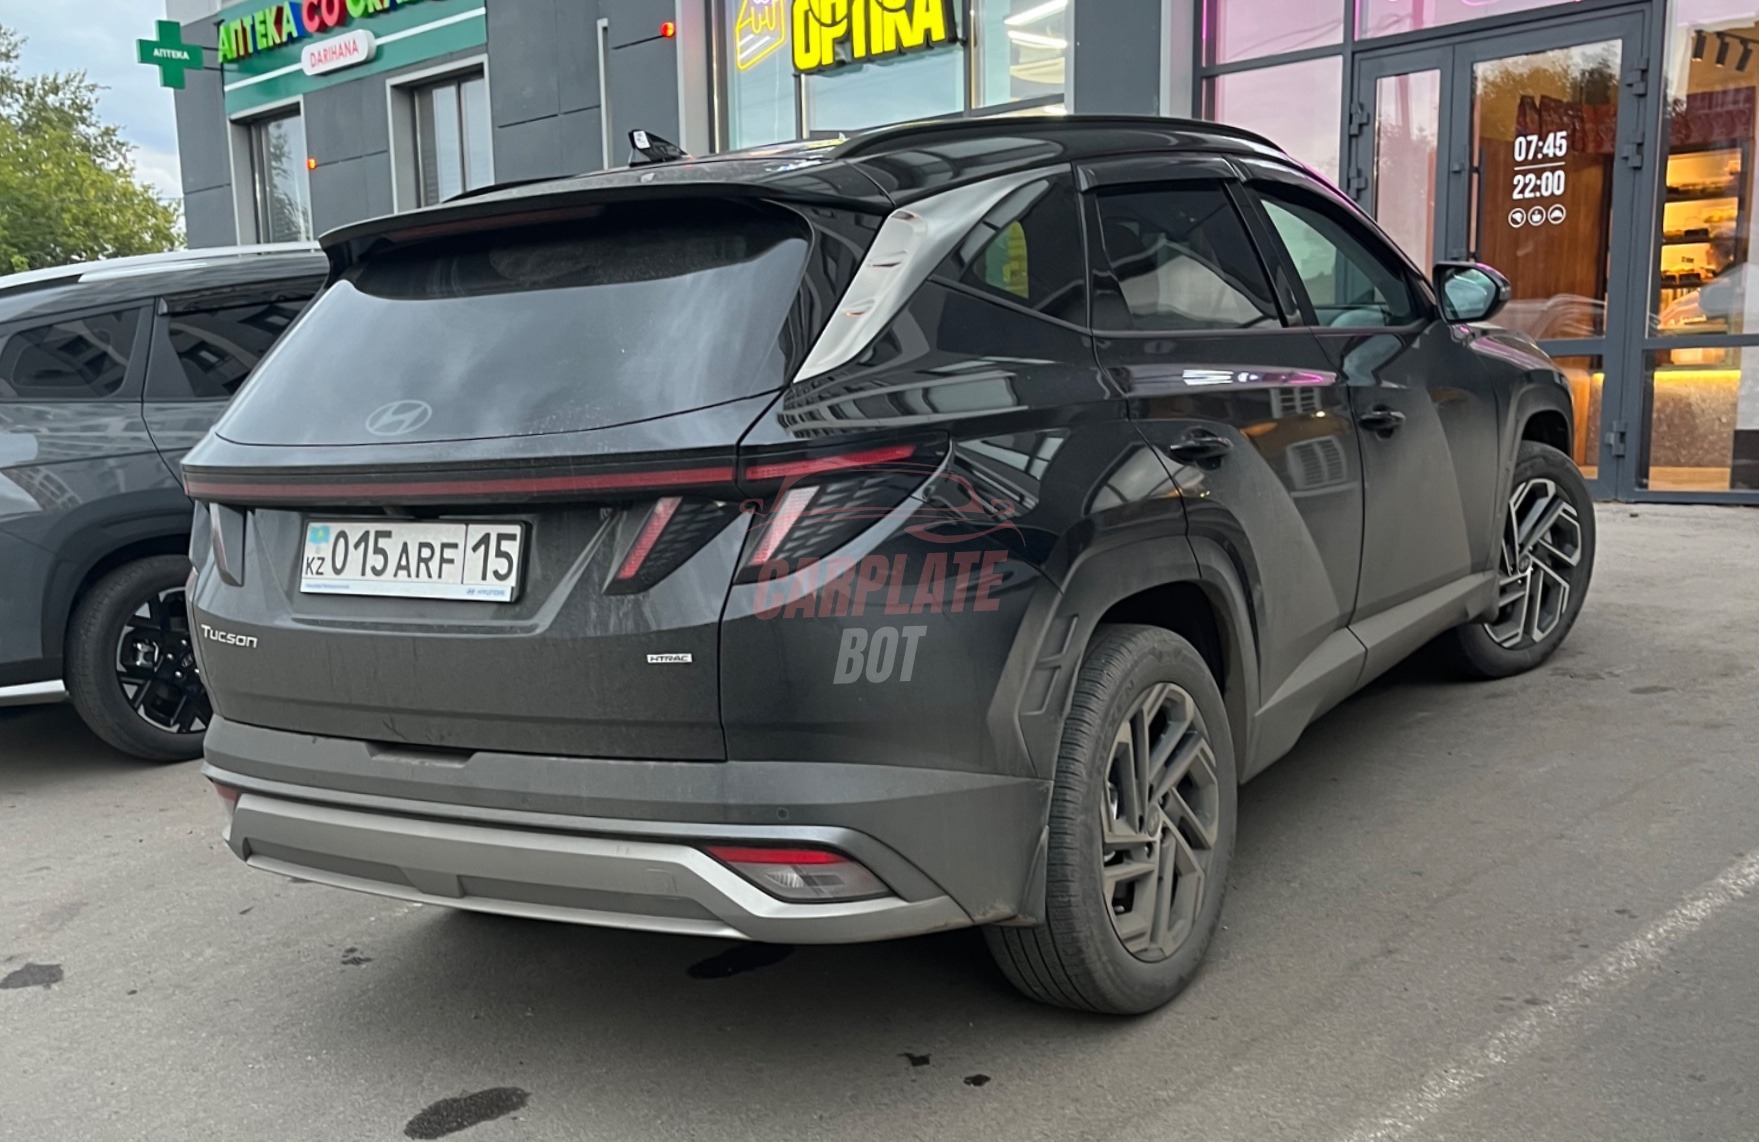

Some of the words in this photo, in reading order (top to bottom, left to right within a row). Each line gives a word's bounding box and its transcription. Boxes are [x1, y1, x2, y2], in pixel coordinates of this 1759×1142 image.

[217, 0, 298, 63] АПТЕКА
[153, 48, 190, 60] АПТЕКА
[310, 39, 359, 68] DARIHANA
[1514, 130, 1567, 161] 07:45
[1512, 170, 1565, 200] 22:00
[305, 556, 325, 576] KZ
[648, 654, 690, 662] HTRAC
